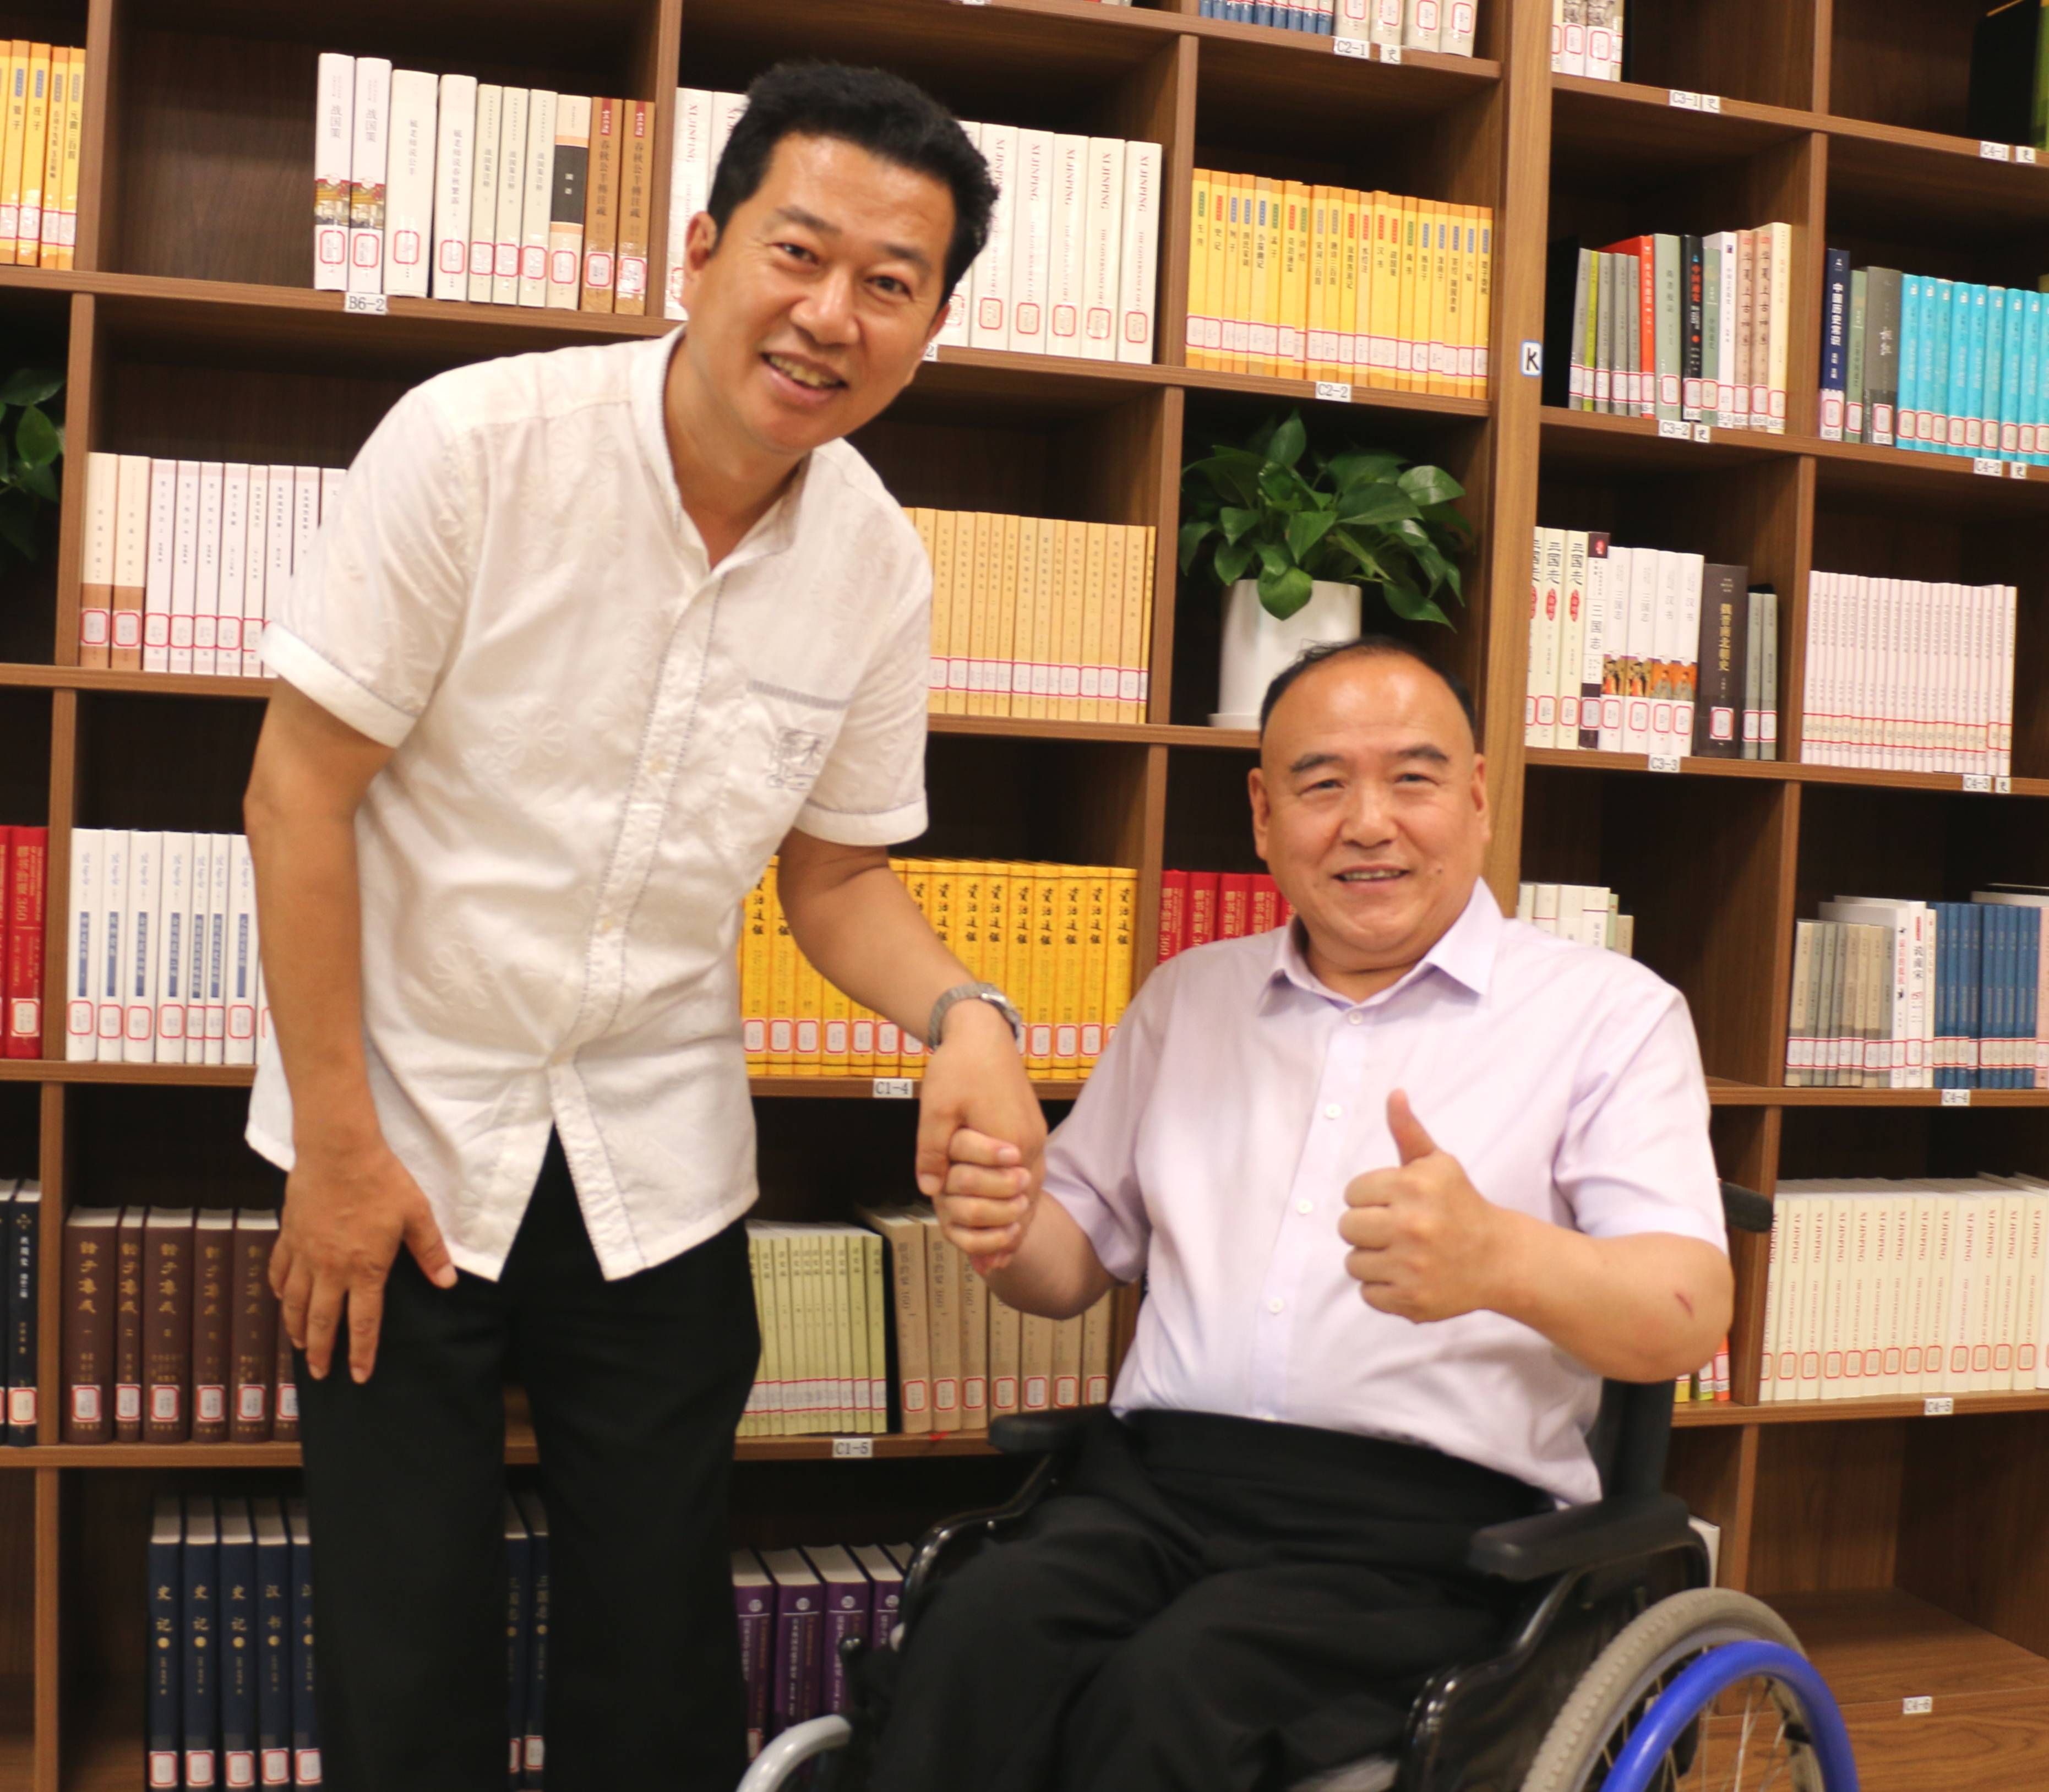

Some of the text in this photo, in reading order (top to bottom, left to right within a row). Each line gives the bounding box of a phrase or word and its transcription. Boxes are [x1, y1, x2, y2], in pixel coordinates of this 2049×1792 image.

[1337, 41, 1366, 56] C2-1
[1672, 91, 1698, 107] C3-1
[994, 154, 1005, 188] JINPI
[1029, 144, 1041, 202] XI JINPING
[1064, 148, 1076, 206] XI JINPING
[1100, 152, 1111, 210] XI JINPING
[1138, 155, 1149, 212] XI JINPING
[348, 296, 385, 312] B6-2
[1526, 347, 1540, 370] K
[1317, 383, 1348, 399] C2-2
[1660, 422, 1689, 436] C3-2
[1651, 756, 1679, 770] C3-3
[875, 1081, 908, 1094] C1-4
[1791, 1213, 1801, 1263] XI JINPING
[1813, 1212, 1823, 1263] XI JINPING
[1837, 1212, 1846, 1262] XI JINPING
[1857, 1212, 1867, 1262] XI JINPING
[1877, 1211, 1887, 1261] XI JINPING
[1896, 1211, 1906, 1260] XI JINPING
[1919, 1211, 1928, 1260] XI JINPING
[1939, 1211, 1950, 1260] XI JINPING
[1964, 1213, 1974, 1261] XI JINPING
[1986, 1210, 1996, 1259] XI JINPING
[2007, 1211, 2018, 1259] XI JINPING
[2031, 1210, 2041, 1259] XI JINPING
[835, 1441, 870, 1455] C1-5
